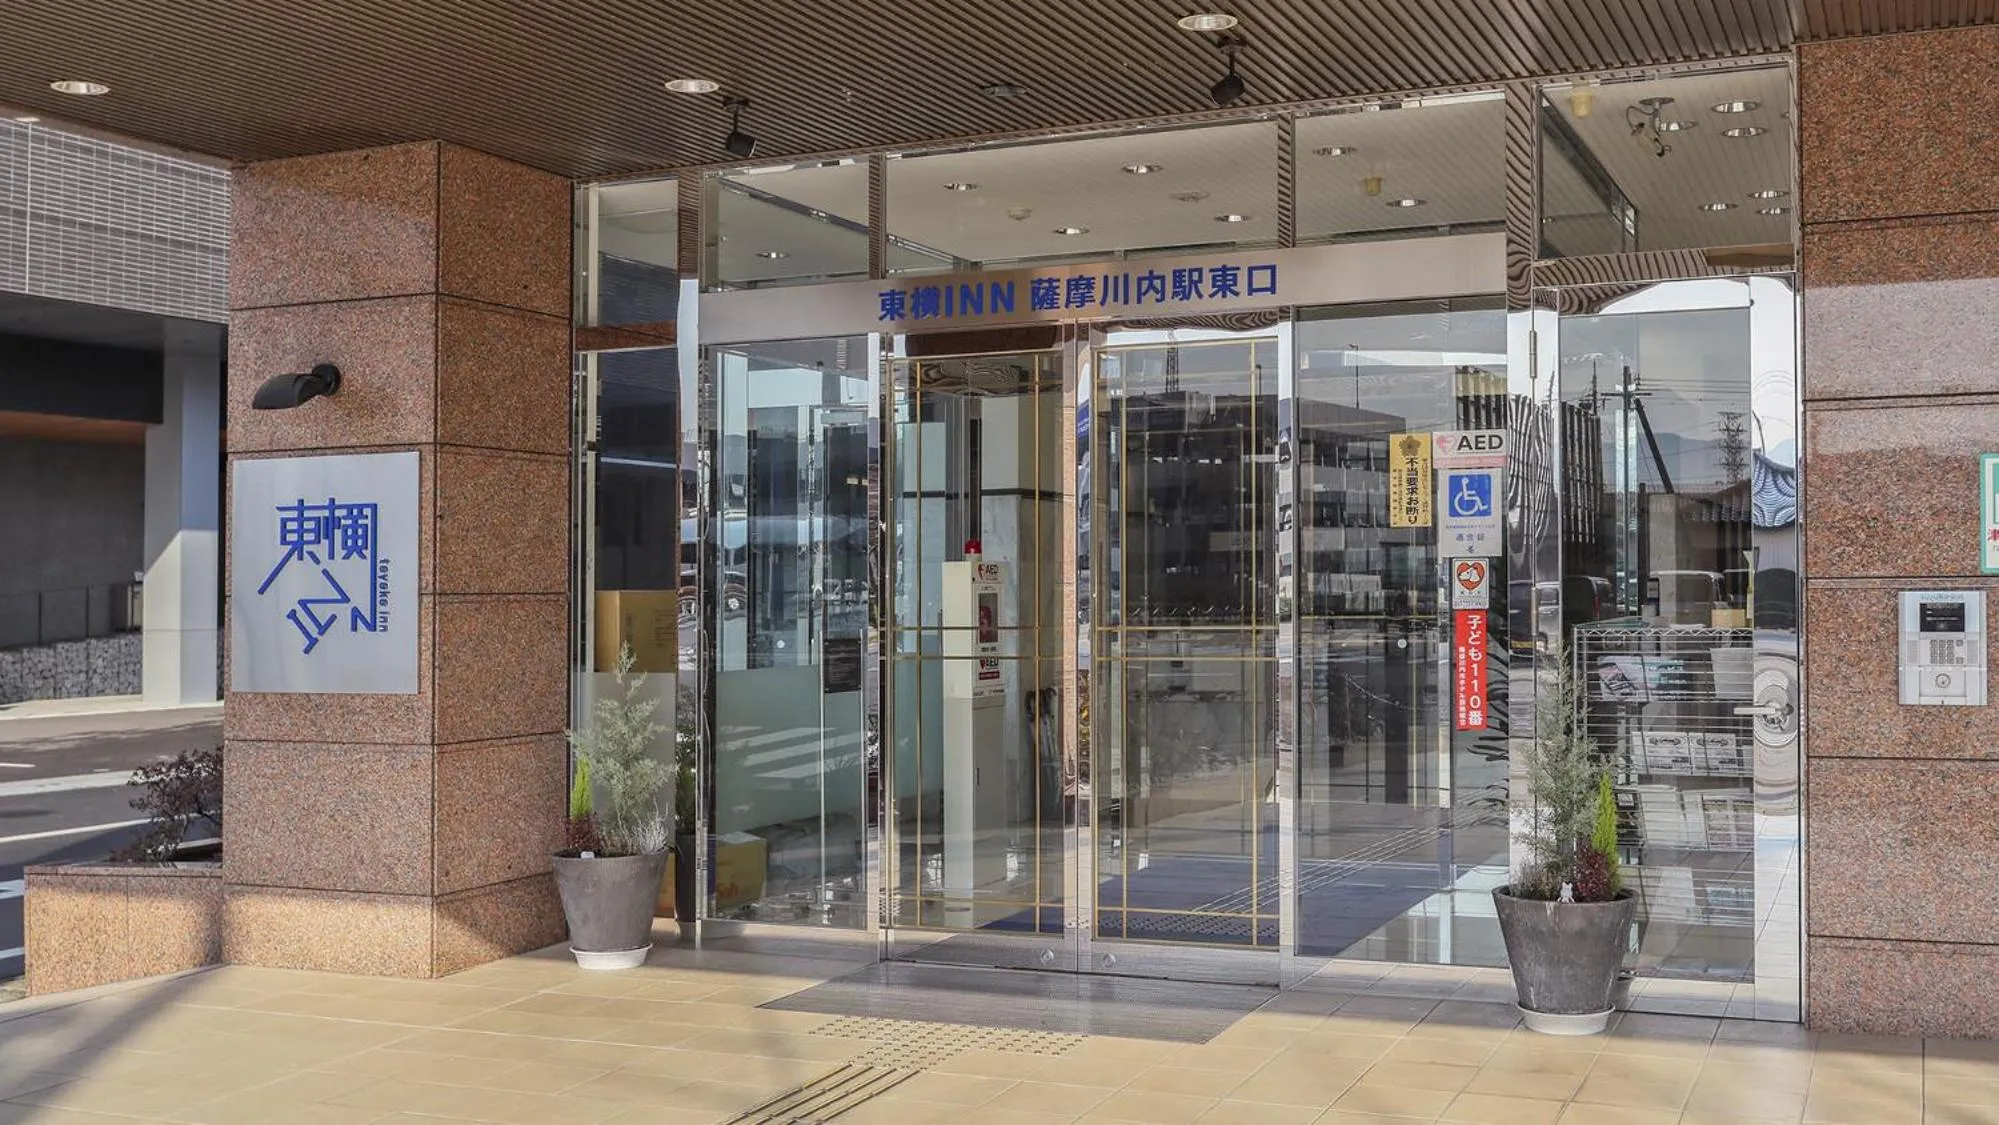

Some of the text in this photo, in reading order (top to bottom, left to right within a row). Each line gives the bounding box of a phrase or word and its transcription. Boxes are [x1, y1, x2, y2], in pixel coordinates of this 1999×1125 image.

[878, 264, 1277, 322] 東横INN 薩摩川内駅東口
[1457, 434, 1503, 451] AED
[1405, 457, 1420, 525] 不当要求お断り
[1467, 614, 1483, 726] 子ども110番
